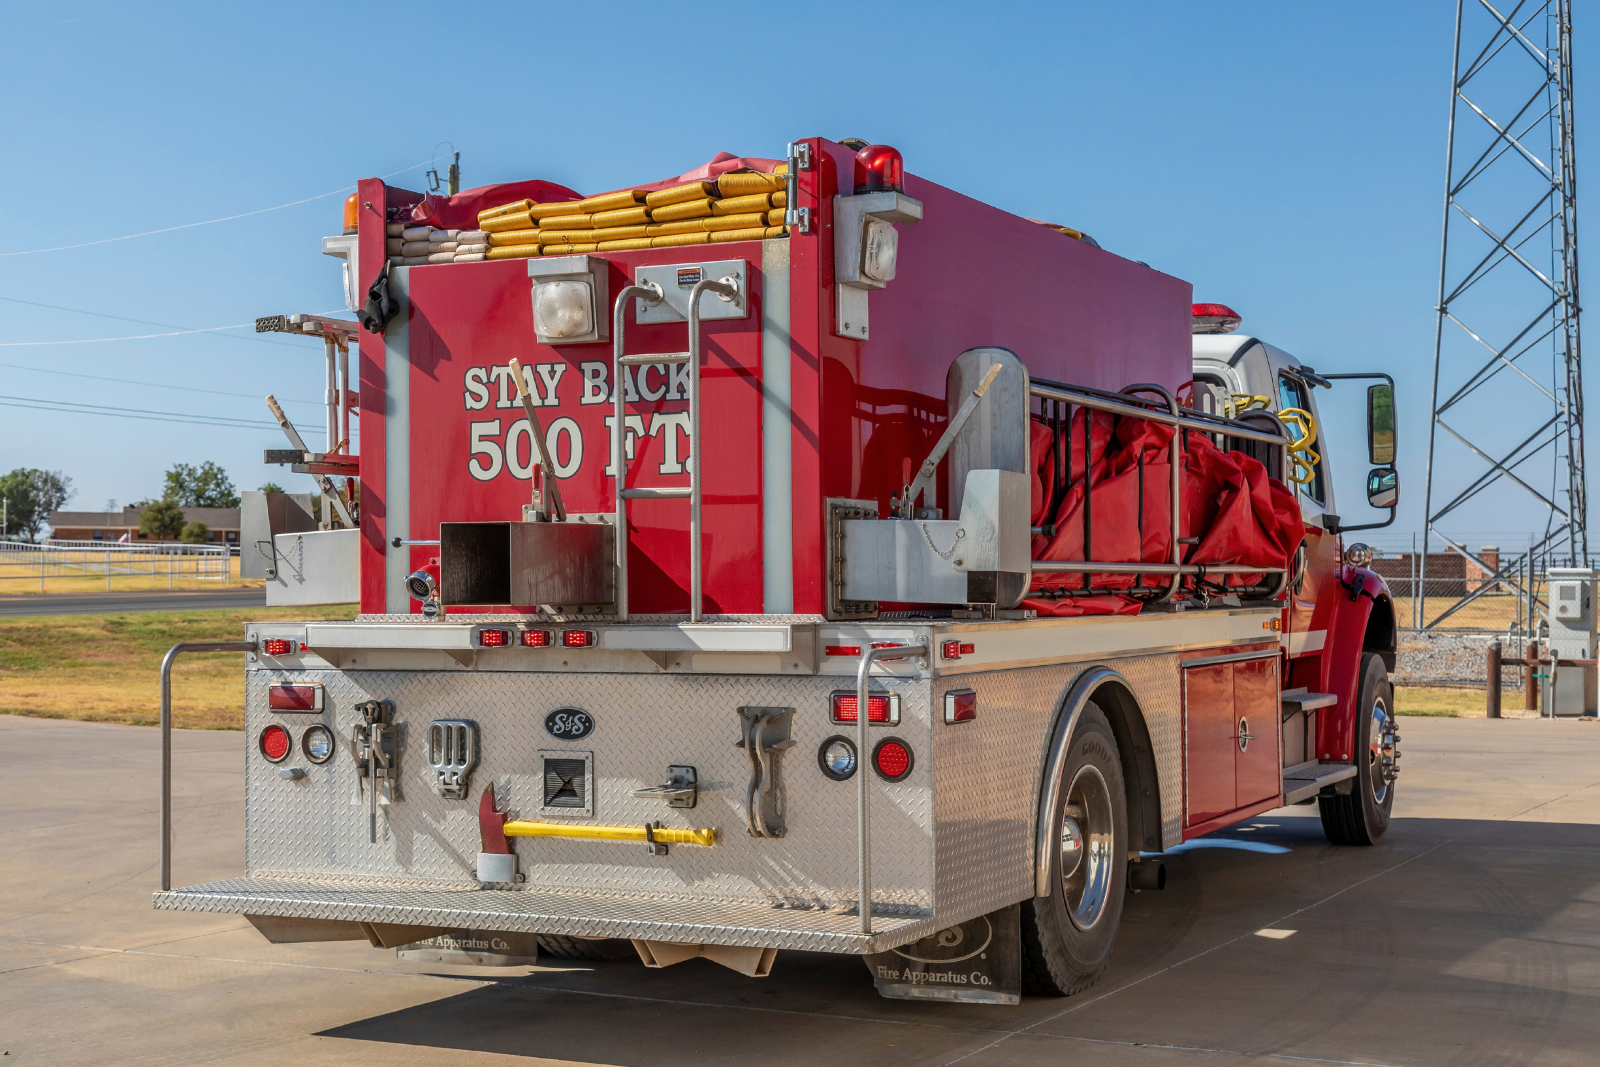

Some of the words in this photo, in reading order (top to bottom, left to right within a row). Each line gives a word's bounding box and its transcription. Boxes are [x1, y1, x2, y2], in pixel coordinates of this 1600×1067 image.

[463, 362, 567, 411] STAY
[580, 360, 690, 406] BACK
[468, 416, 584, 482] 500
[435, 935, 489, 950] Apparatus
[491, 937, 510, 950] Co.
[877, 965, 900, 979] Fire
[902, 967, 968, 985] Apparatus
[970, 971, 992, 986] Co.
